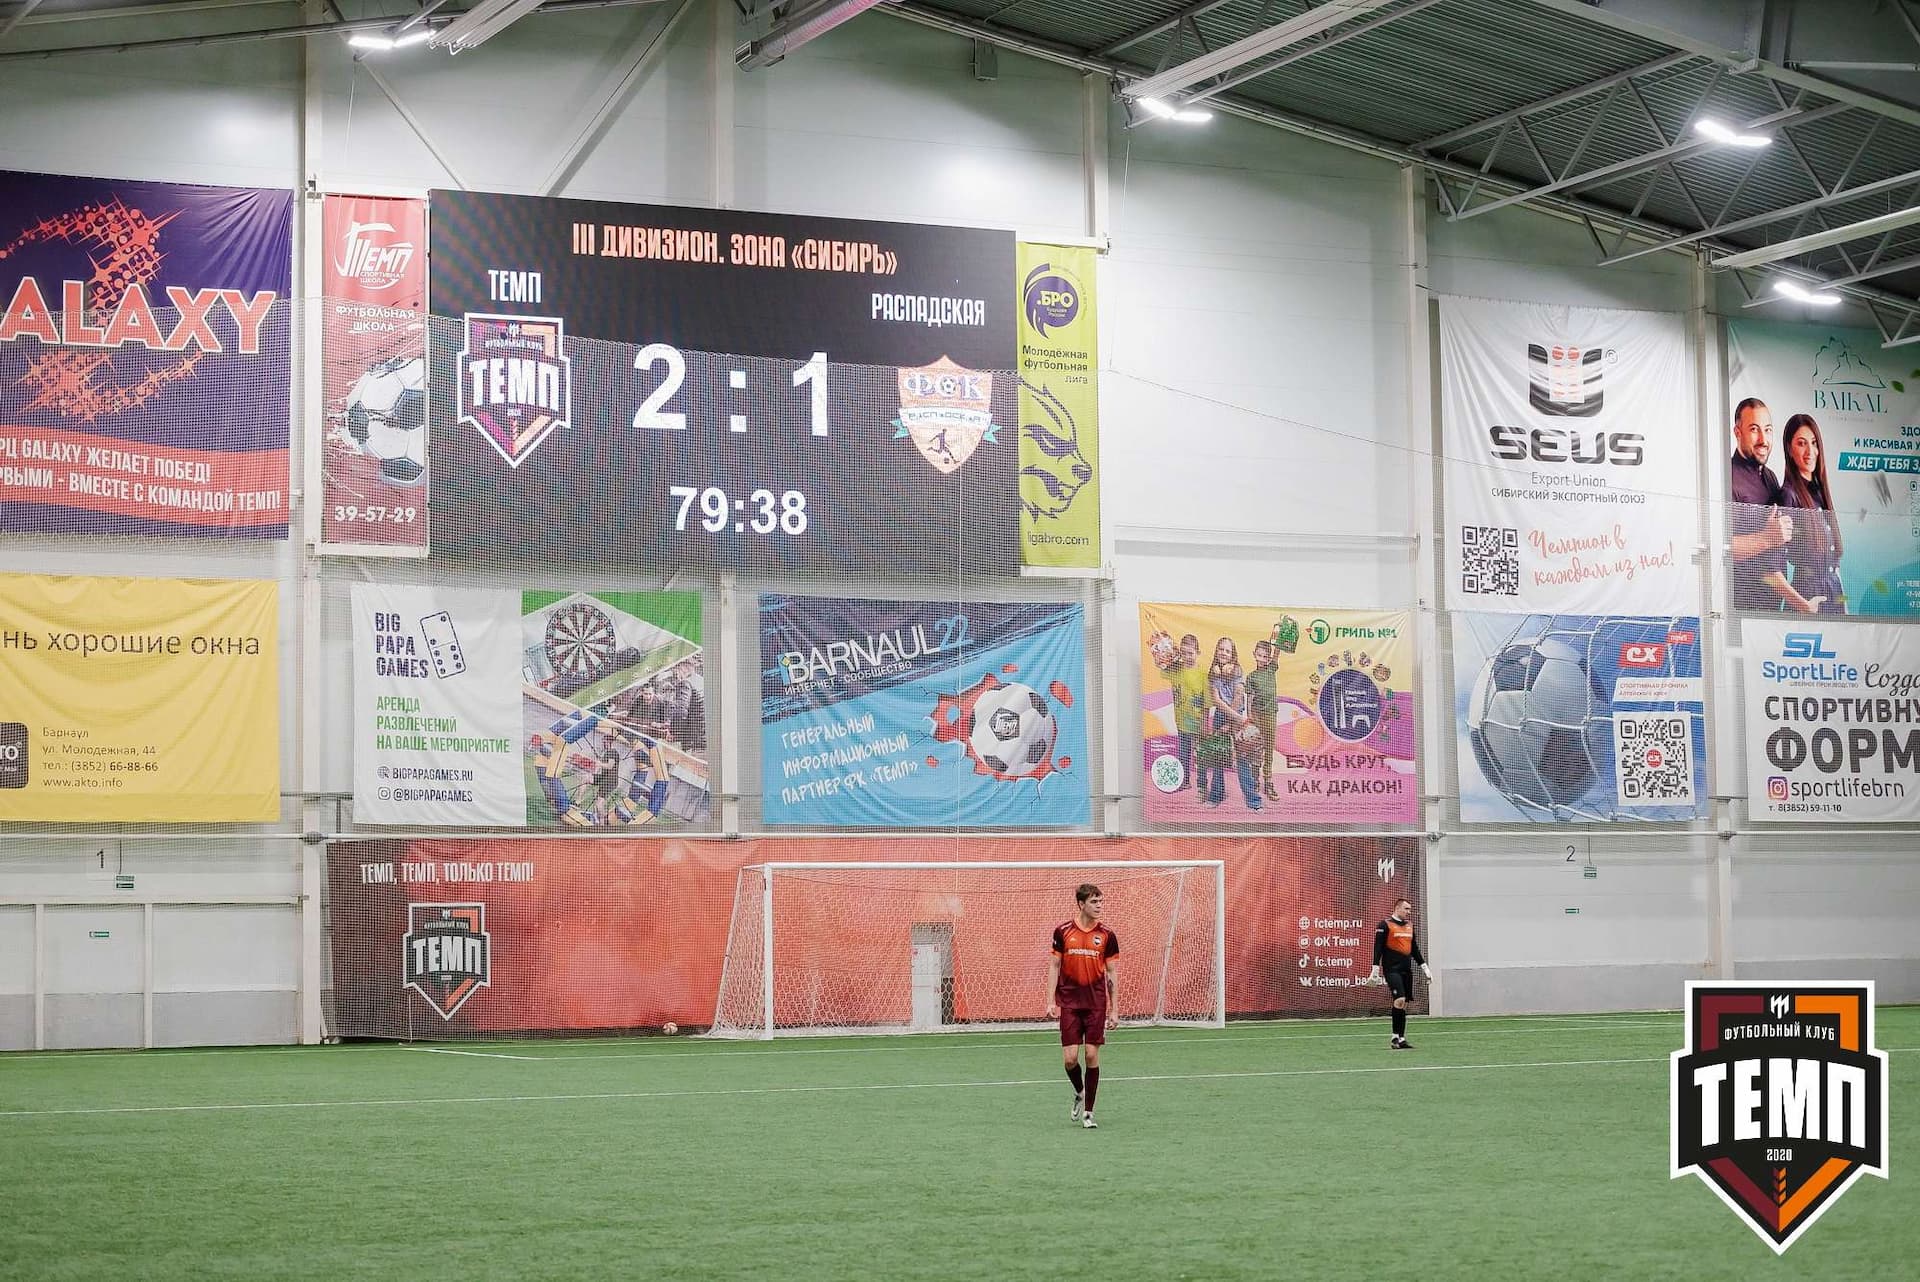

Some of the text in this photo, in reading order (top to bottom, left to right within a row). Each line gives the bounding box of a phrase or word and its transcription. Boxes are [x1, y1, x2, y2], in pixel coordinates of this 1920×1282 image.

[573, 223, 898, 275] III ДИВИЗИОН. ЗОНА «СИБИРЬ»
[488, 269, 541, 303] ТЕМП
[0, 276, 277, 354] ALAXY
[336, 306, 416, 319] ФУТБОЛЬНАЯ
[872, 293, 985, 328] РАСПАДСКАЯ
[353, 321, 395, 332] ШКОЛА
[1024, 359, 1088, 372] футбольная
[469, 358, 560, 412] ТЕМП
[632, 343, 828, 437] 2 : 1
[1065, 376, 1088, 385] лига
[1814, 390, 1888, 414] BAIKAL
[1489, 425, 1645, 466] SEUS
[1854, 438, 1860, 448] И
[1863, 439, 1912, 450] КРАСИВАЯ
[22, 439, 82, 465] GALAXY
[86, 446, 150, 476] ЖЕЛАЕТ
[154, 457, 211, 483] ПОБЕД!
[1847, 455, 1881, 470] ЖДЕТ
[1883, 457, 1910, 471] ТЕБЯ
[69, 473, 130, 500] ВМЕСТЕ
[134, 483, 144, 502] С
[148, 484, 234, 512] КОМАНДОЙ
[238, 490, 281, 510] ТЕМП!
[1491, 487, 1646, 504] СИБИРСКИЙ ЭКСПОРТНЫЙ СОЮЗ
[334, 505, 416, 522] 39-57-29
[670, 486, 808, 536] 79:38
[1027, 531, 1089, 546] ligabro.com
[1528, 524, 1627, 558] Чемпион в
[1534, 540, 1675, 586] каждом из нас!
[375, 612, 400, 632] BIG
[1335, 627, 1397, 639] ГРИЛЬ №1
[47, 630, 182, 658] хорошие
[191, 632, 260, 655] окна
[376, 634, 416, 656] PAPA
[376, 657, 429, 679] GAMES
[784, 677, 836, 695] ИНТЕРНЕТ
[843, 660, 912, 683] СООБЩЕСТВО
[1762, 661, 1858, 683] SportLife
[376, 696, 421, 713] АРЕНДА
[42, 727, 89, 740] Барнаул
[376, 715, 457, 733] РАЗВЛЕЧЕНИЙ
[781, 711, 875, 749] ГЕНЕРАЛЬНЫЙ
[142, 746, 156, 755] 44
[376, 735, 511, 753] НА ВАШЕ МЕРОПРИЯТИЕ
[1765, 727, 1920, 774] ФОРМ
[782, 731, 909, 779] ИНФОРМАЦИОННЫЙ
[1286, 755, 1391, 772] БУДЬ КРУТ,
[71, 760, 106, 773] (3852)
[110, 762, 159, 772] 66-88-66
[392, 767, 473, 781] BIGPAPAGAMES.RU
[42, 777, 123, 788] www.akto.info
[782, 760, 919, 806] ПАРТНЕР ФК «ТЕМП»
[1287, 779, 1403, 797] КАК ДРАКОН!
[1791, 778, 1905, 801] sportlifebrn
[393, 788, 473, 802] @BIGPAPAGAMES
[1778, 804, 1809, 813] 8(3852)
[1810, 804, 1842, 813] 59-11-10
[96, 849, 104, 869] 1
[1566, 845, 1576, 862] 2
[360, 862, 534, 884] ТЕМП, ТЕМП, ТОЛЬКО ТЕМП!
[1314, 918, 1362, 930] fctemp.ru
[1314, 936, 1360, 947] ФК Темп
[413, 935, 481, 976] ТЕМП
[1315, 955, 1353, 968] fc.temp
